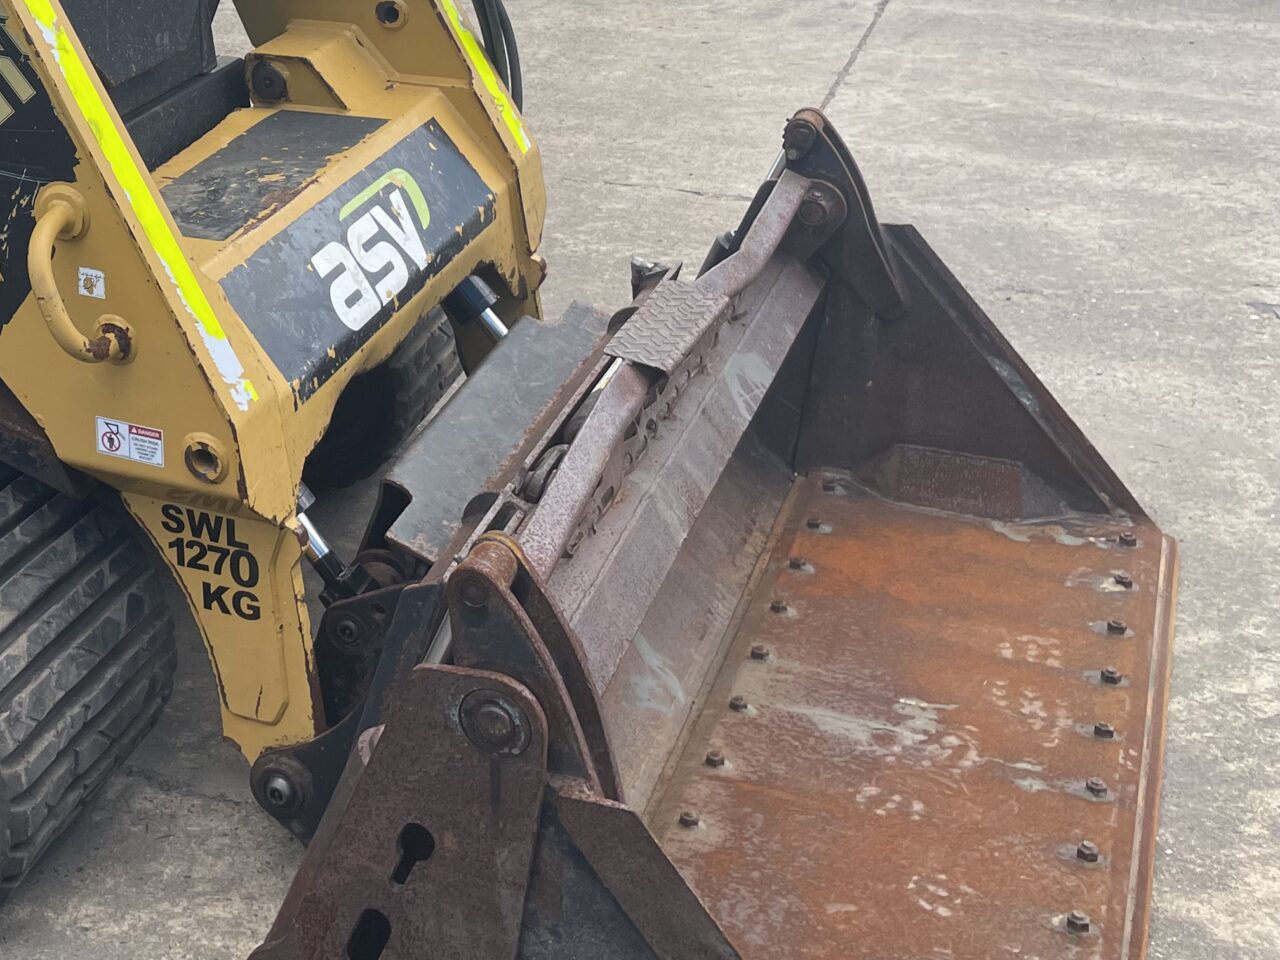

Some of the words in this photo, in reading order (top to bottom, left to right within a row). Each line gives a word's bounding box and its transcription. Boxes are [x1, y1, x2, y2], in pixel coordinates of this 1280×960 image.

[311, 189, 428, 331] asv
[137, 428, 160, 438] DANGER
[161, 504, 249, 550] SWL
[168, 537, 259, 588] 1270
[202, 581, 261, 621] KG
